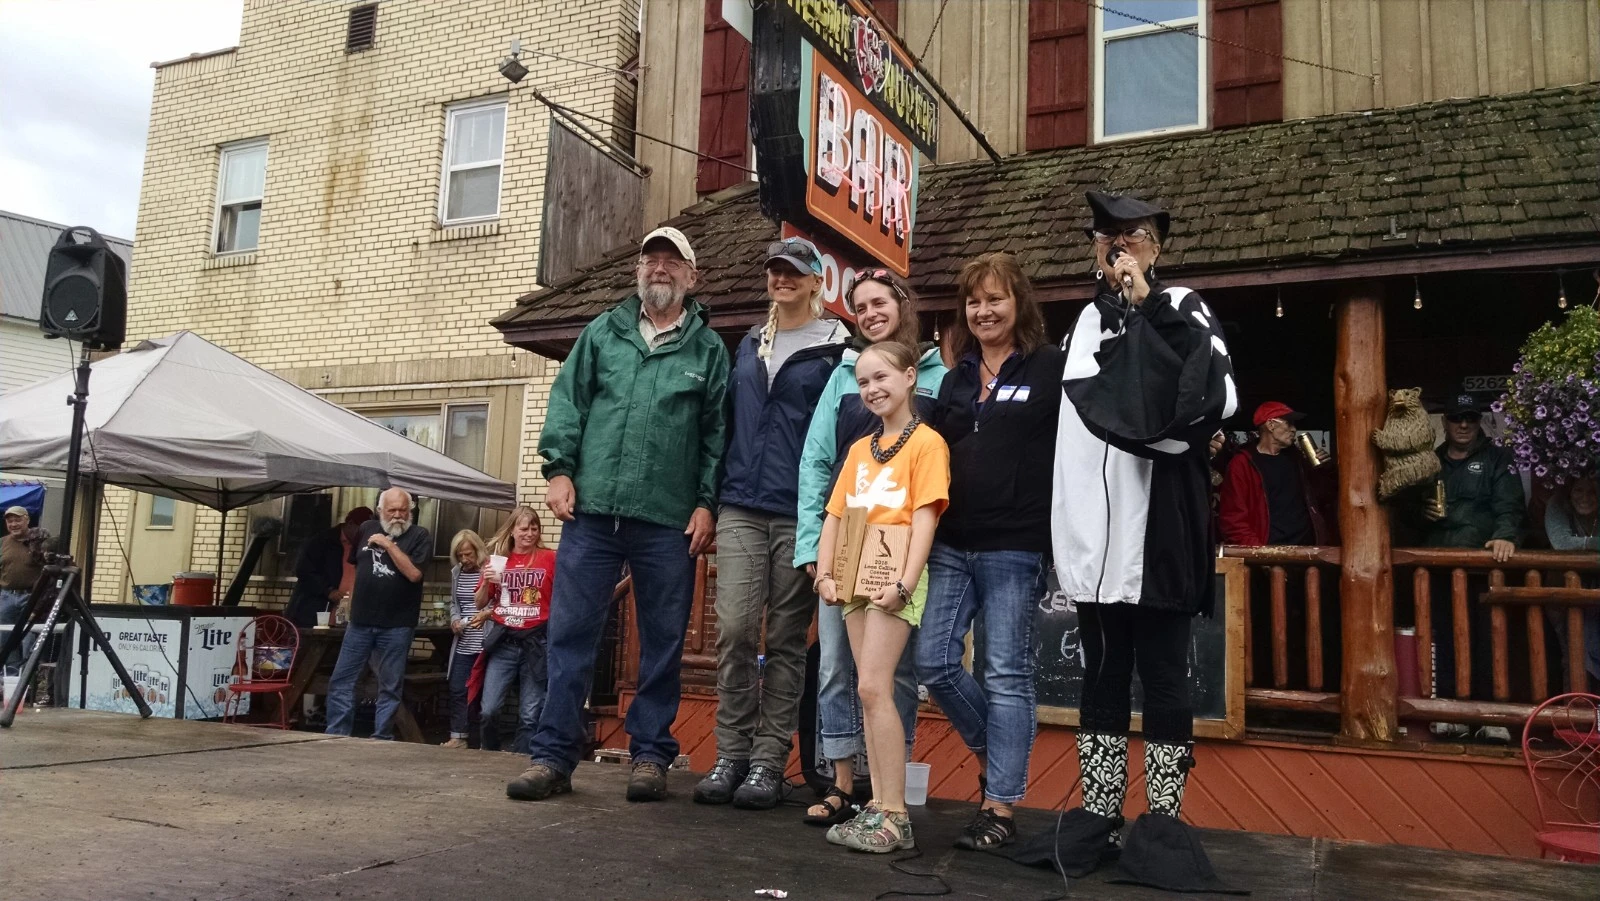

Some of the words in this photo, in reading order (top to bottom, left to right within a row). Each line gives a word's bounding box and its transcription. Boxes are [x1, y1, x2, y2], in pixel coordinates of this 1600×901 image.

[884, 57, 936, 147] NORTH
[816, 70, 912, 241] BAR
[861, 579, 896, 587] Champio
[119, 632, 142, 642] GREAT
[144, 633, 168, 643] TASTE
[201, 628, 232, 651] Lite
[213, 673, 230, 688] Lite
